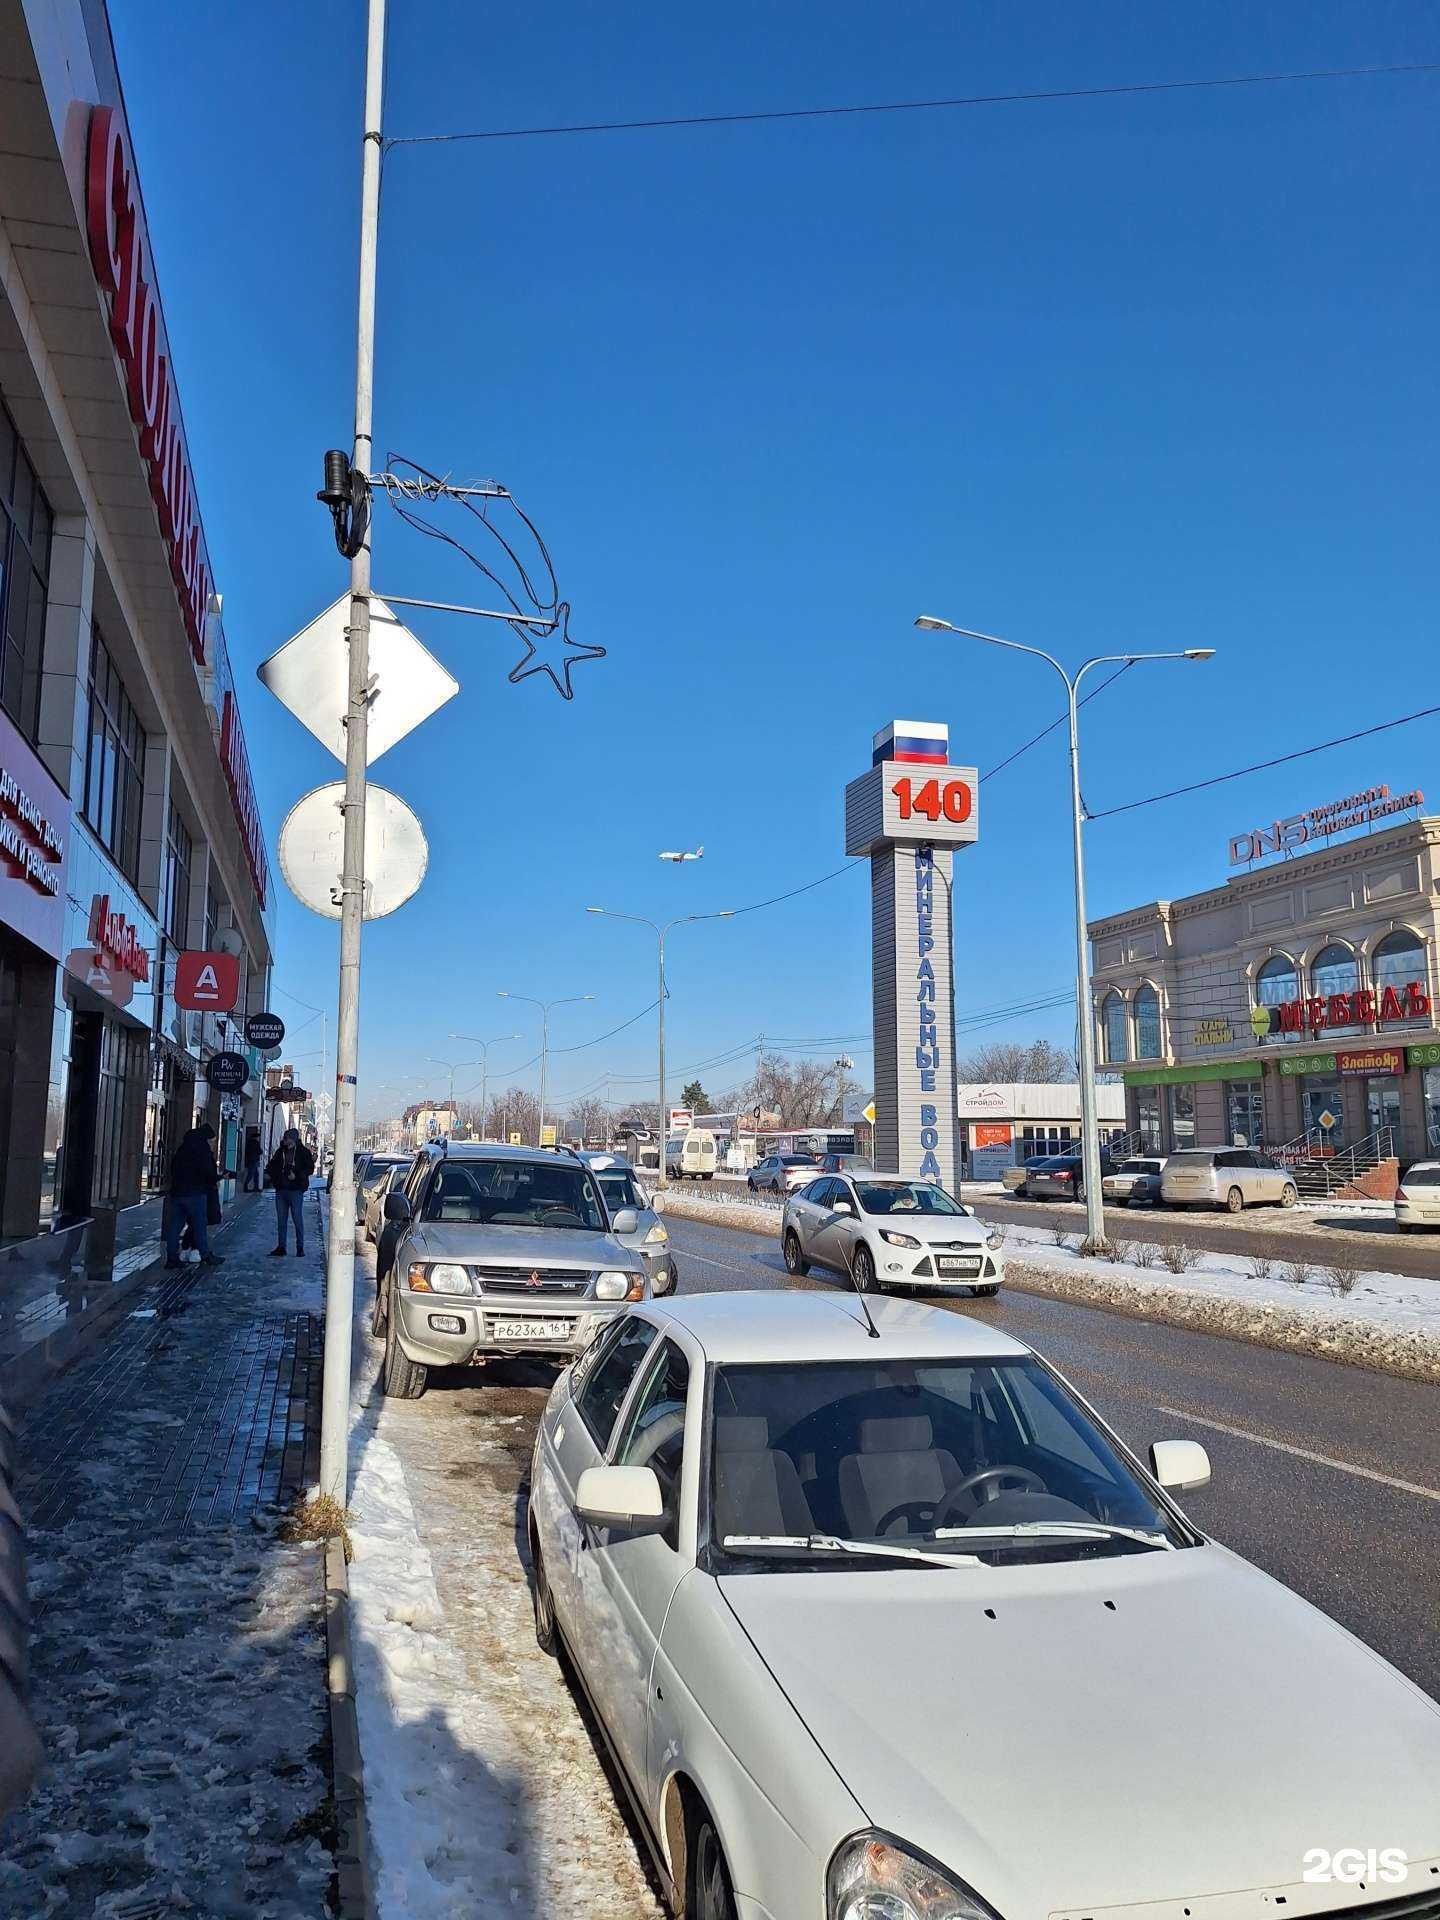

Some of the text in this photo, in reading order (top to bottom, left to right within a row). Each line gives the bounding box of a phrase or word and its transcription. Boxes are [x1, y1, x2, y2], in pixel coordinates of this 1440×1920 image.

[892, 777, 972, 823] 140
[1229, 814, 1307, 866] DNS
[25, 847, 59, 896] ремонта
[914, 847, 940, 1092] МИНЕРАЛЬНЫЕ
[1279, 981, 1432, 1033] МЕБЕЛЬ
[250, 1031, 280, 1039] ОДЕЖДА
[1342, 1052, 1399, 1073] ЗлатоЯр
[919, 1104, 943, 1187] ВОД
[499, 1320, 567, 1338] Р623КА 161
